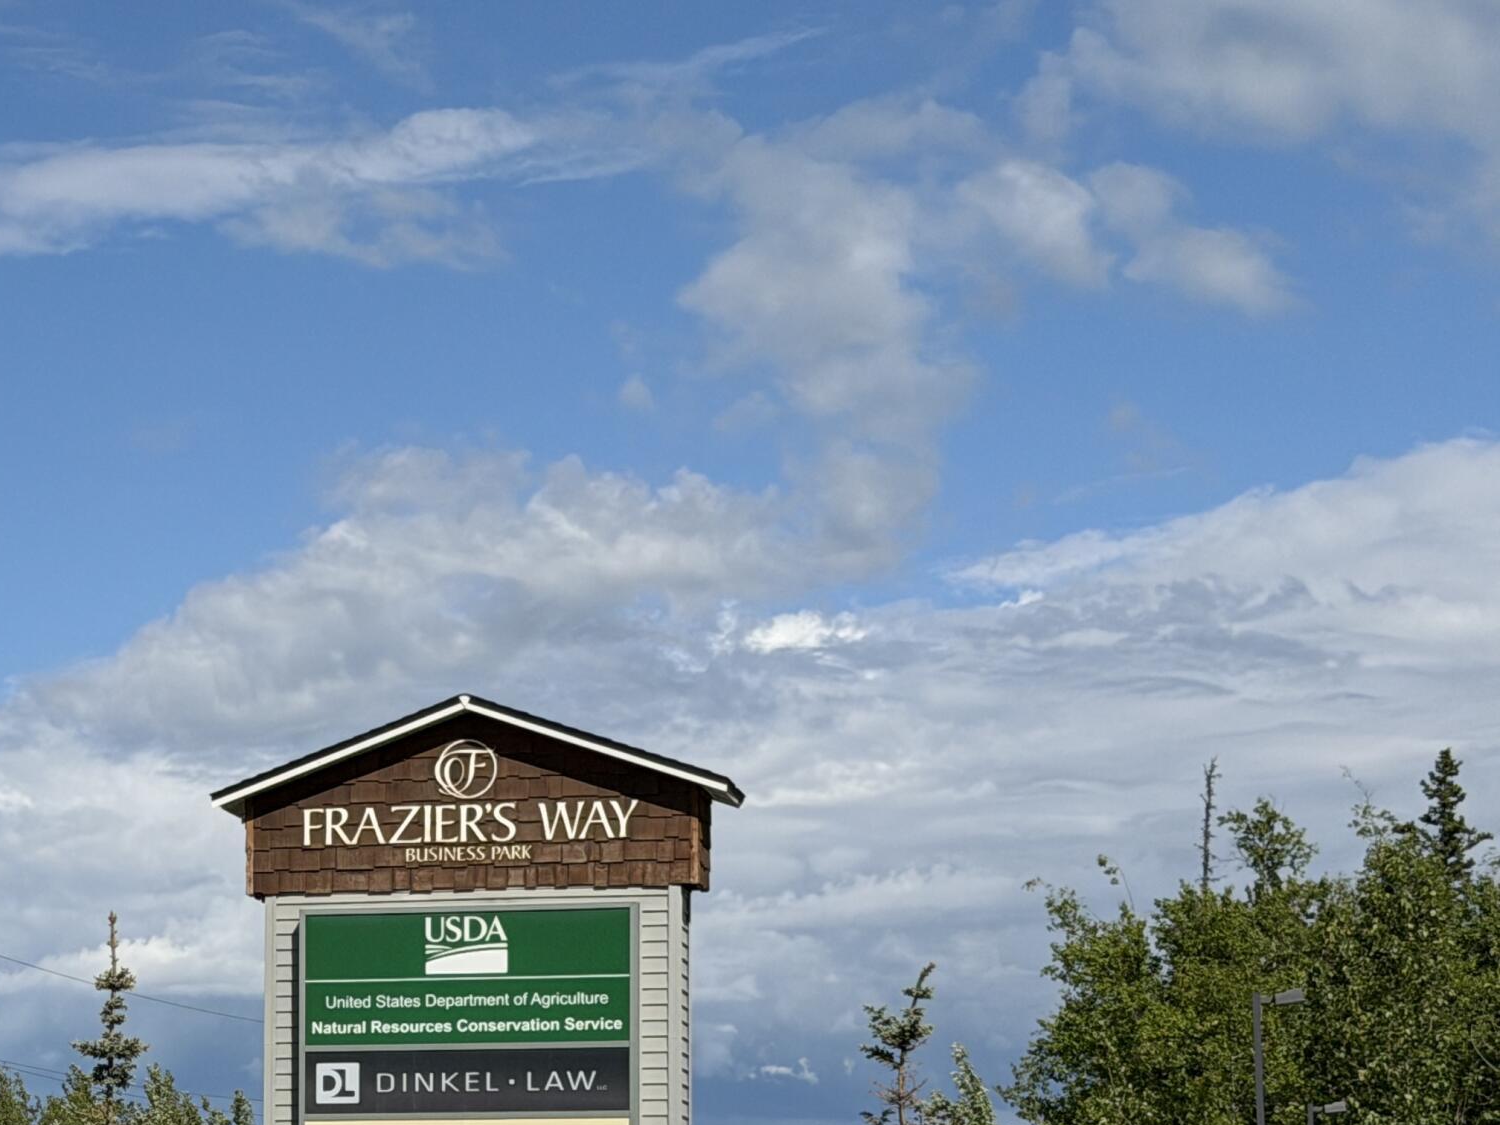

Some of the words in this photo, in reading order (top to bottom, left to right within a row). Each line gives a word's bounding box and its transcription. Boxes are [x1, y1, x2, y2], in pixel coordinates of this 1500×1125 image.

[302, 801, 517, 846] FRAZIER'S
[537, 799, 639, 840] WAY
[405, 846, 485, 862] BUSINESS
[491, 844, 532, 860] PARK
[425, 915, 508, 943] USDA
[325, 996, 371, 1009] United
[375, 995, 421, 1008] States
[425, 994, 510, 1010] Department
[514, 993, 528, 1006] of
[530, 992, 609, 1008] Agriculture
[311, 1021, 366, 1034] Natural
[371, 1020, 452, 1034] Resources
[456, 1018, 560, 1032] Conservation
[564, 1017, 623, 1031] Service
[376, 1072, 499, 1093] DINKEL
[526, 1070, 597, 1092] LAW
